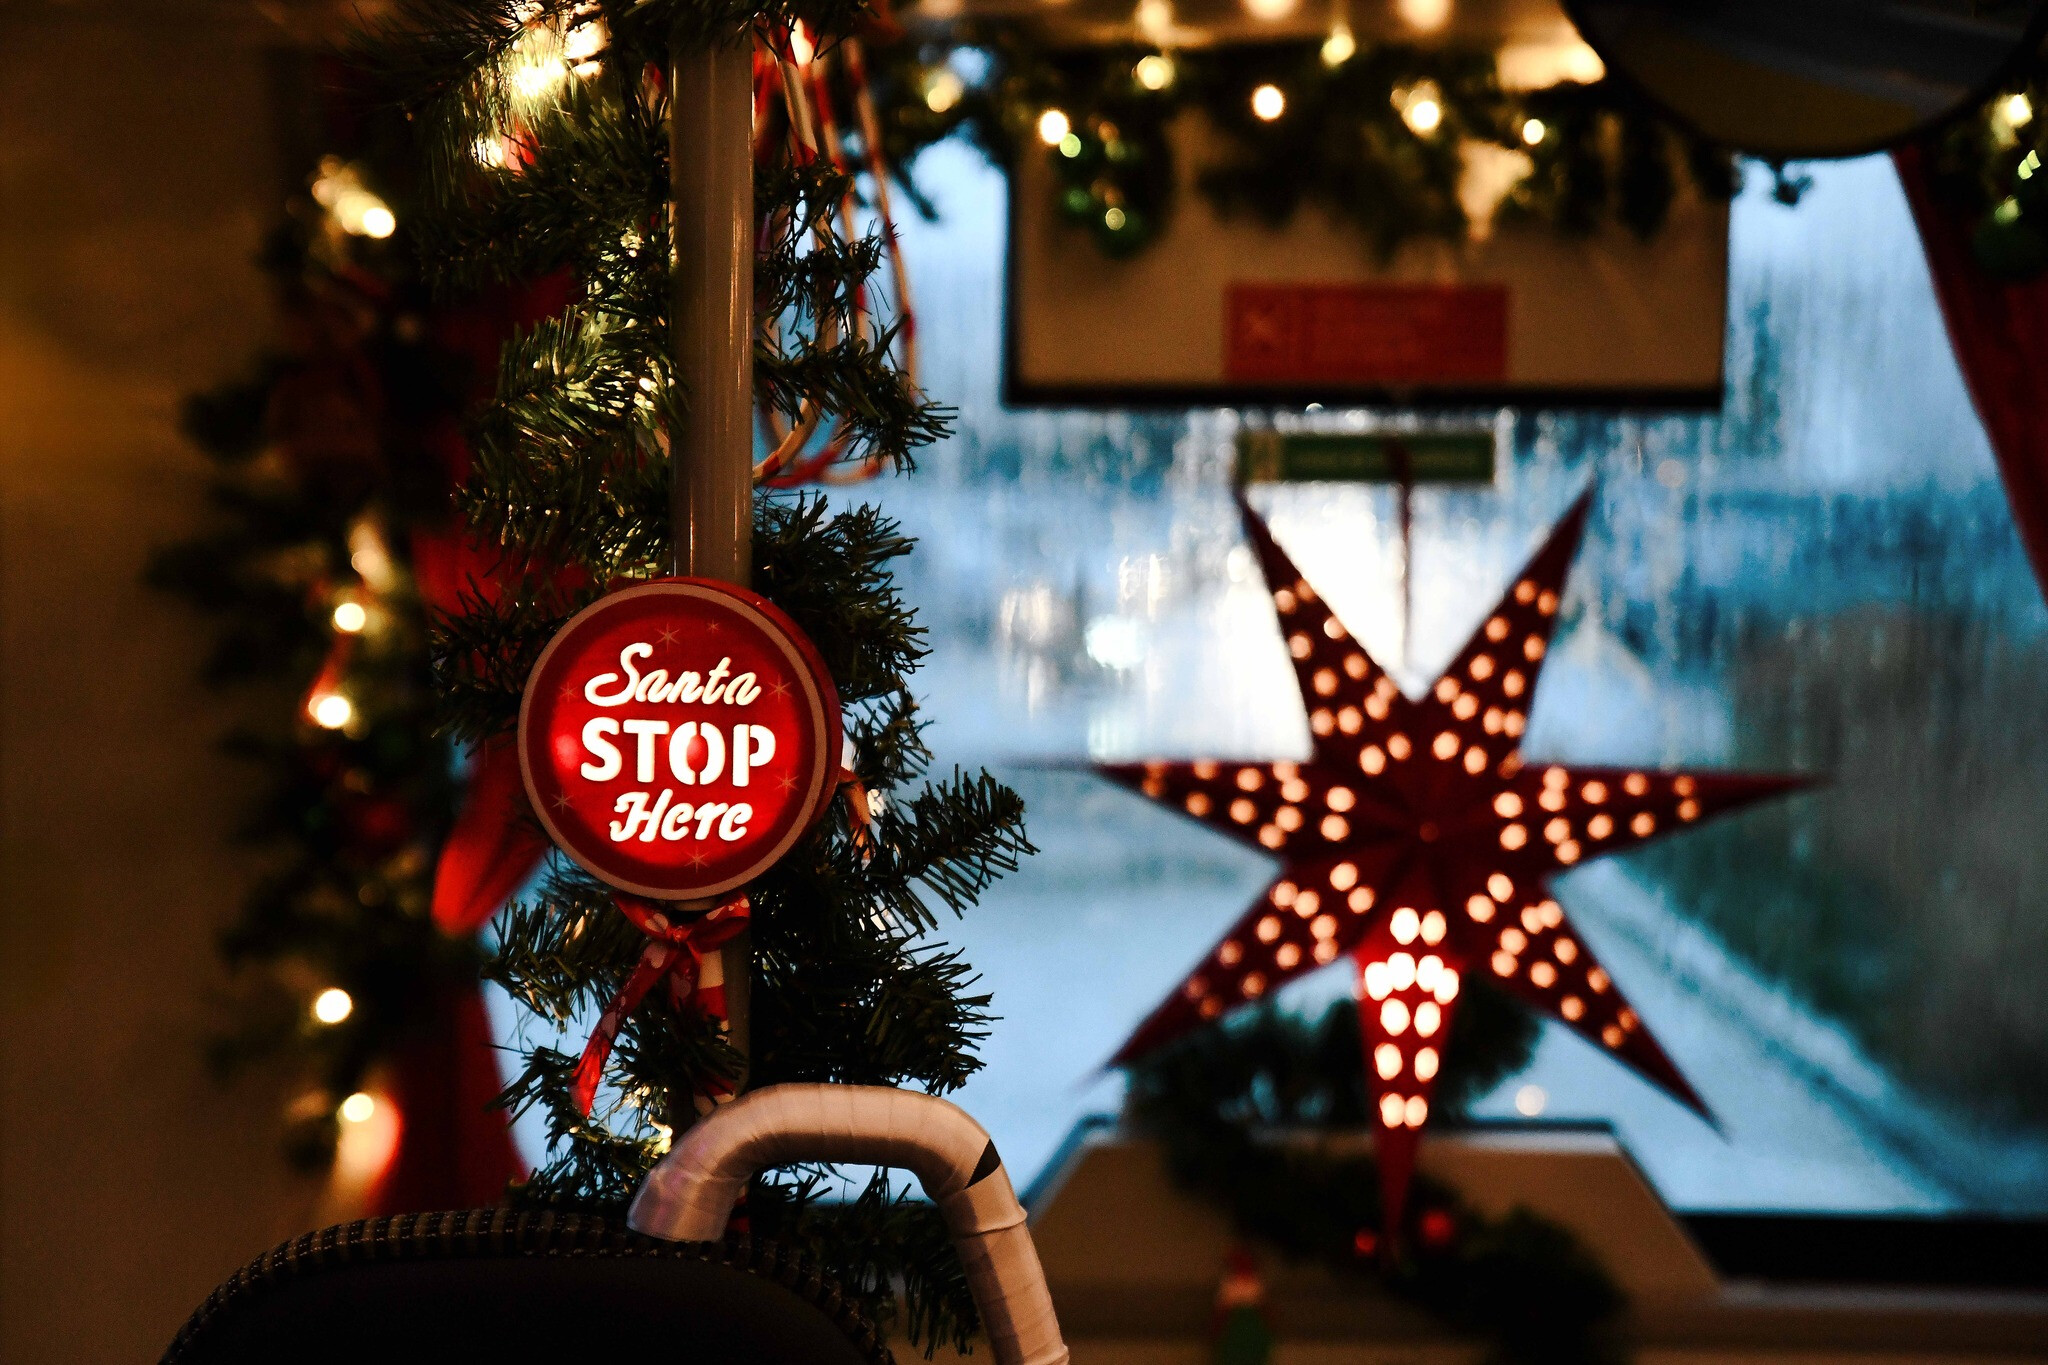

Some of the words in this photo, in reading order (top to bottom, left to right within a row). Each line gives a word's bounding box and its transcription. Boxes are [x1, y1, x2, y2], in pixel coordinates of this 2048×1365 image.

[584, 642, 762, 707] Santa
[580, 717, 776, 787] STOP
[609, 788, 753, 842] Here
